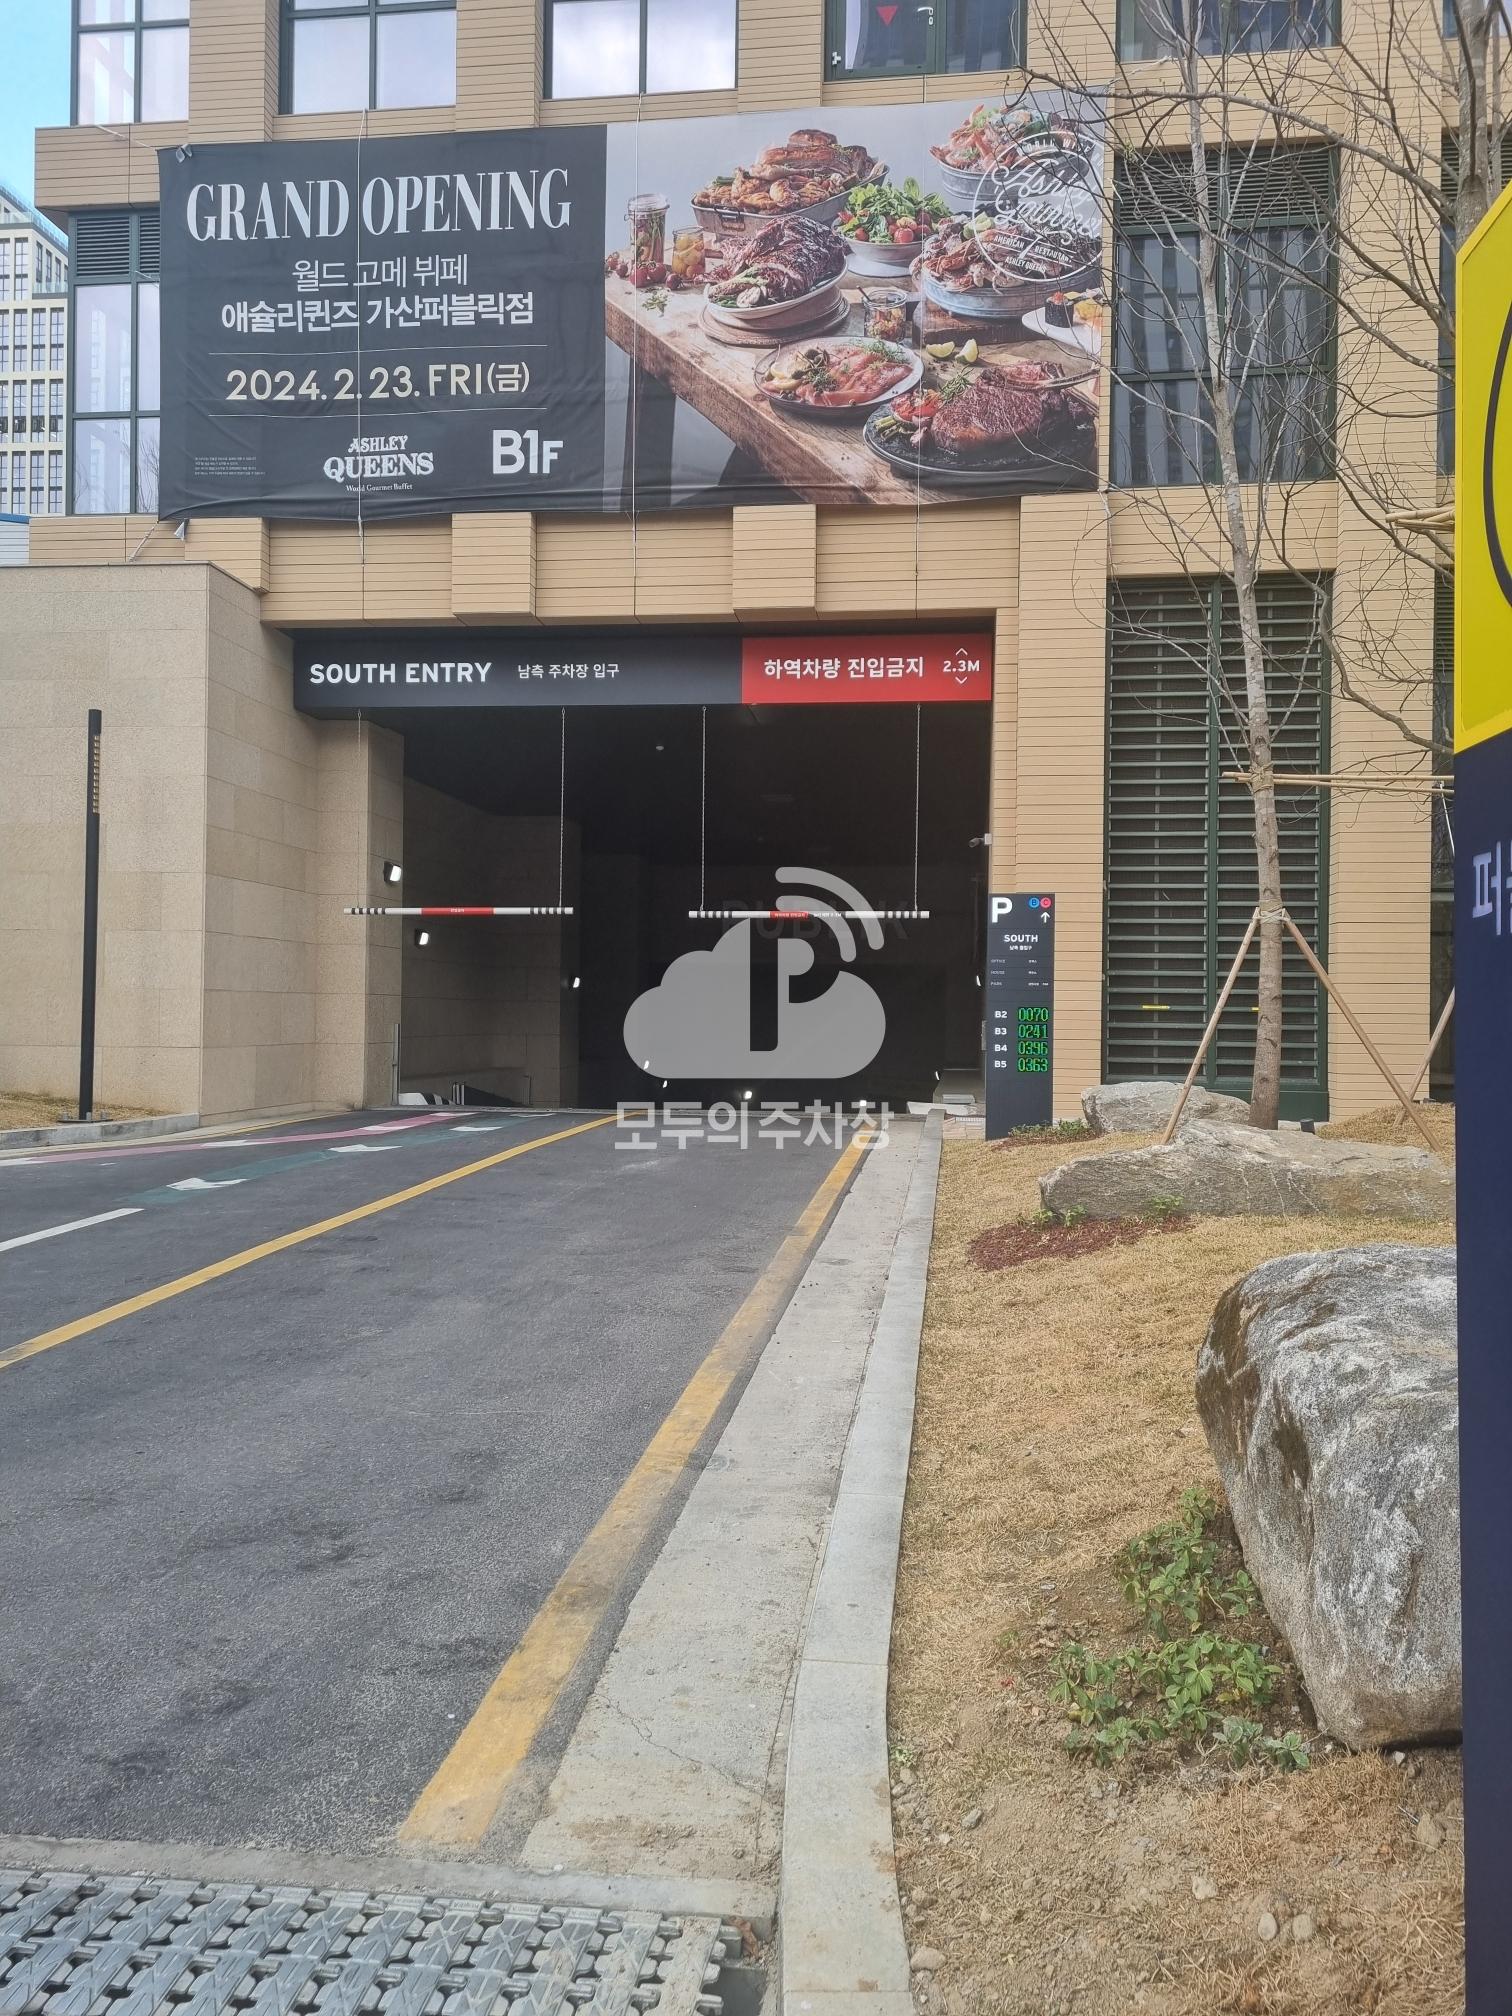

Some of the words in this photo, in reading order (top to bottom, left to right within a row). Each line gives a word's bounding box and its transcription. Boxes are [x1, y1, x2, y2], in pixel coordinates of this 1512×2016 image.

[186, 178, 350, 242] GRAND
[362, 168, 572, 236] OPENING
[993, 235, 1025, 249] AMERICAN
[292, 259, 349, 292] 월드
[353, 256, 407, 288] 고메
[413, 254, 468, 287] 뷔페
[221, 299, 359, 334] 애슐리퀸즈
[366, 291, 534, 329] 가산퍼블릭점
[348, 435, 409, 453] ASHLEY
[492, 429, 564, 475] B1F
[323, 452, 434, 483] QUEENS
[366, 484, 393, 492] Gourmet
[394, 482, 413, 491] Buffet
[309, 663, 396, 684] SOUTH
[405, 662, 492, 683] ENTRY
[517, 664, 544, 679] 남측
[548, 664, 589, 679] 주차장
[593, 663, 620, 679] 입구
[764, 658, 841, 680] 하역차량
[847, 656, 924, 679] 진입금지
[943, 660, 980, 673] 2.3M
[1472, 841, 1512, 936] 퍼
[991, 897, 1013, 923] P
[1003, 934, 1039, 943] SOUTH
[994, 1010, 1008, 1019] B2
[1018, 1007, 1048, 1022] 0070
[994, 1027, 1008, 1036] B3
[1018, 1024, 1048, 1039] 0241
[994, 1044, 1008, 1052] B4
[994, 1060, 1008, 1068] B5
[1018, 1058, 1048, 1072] 0363
